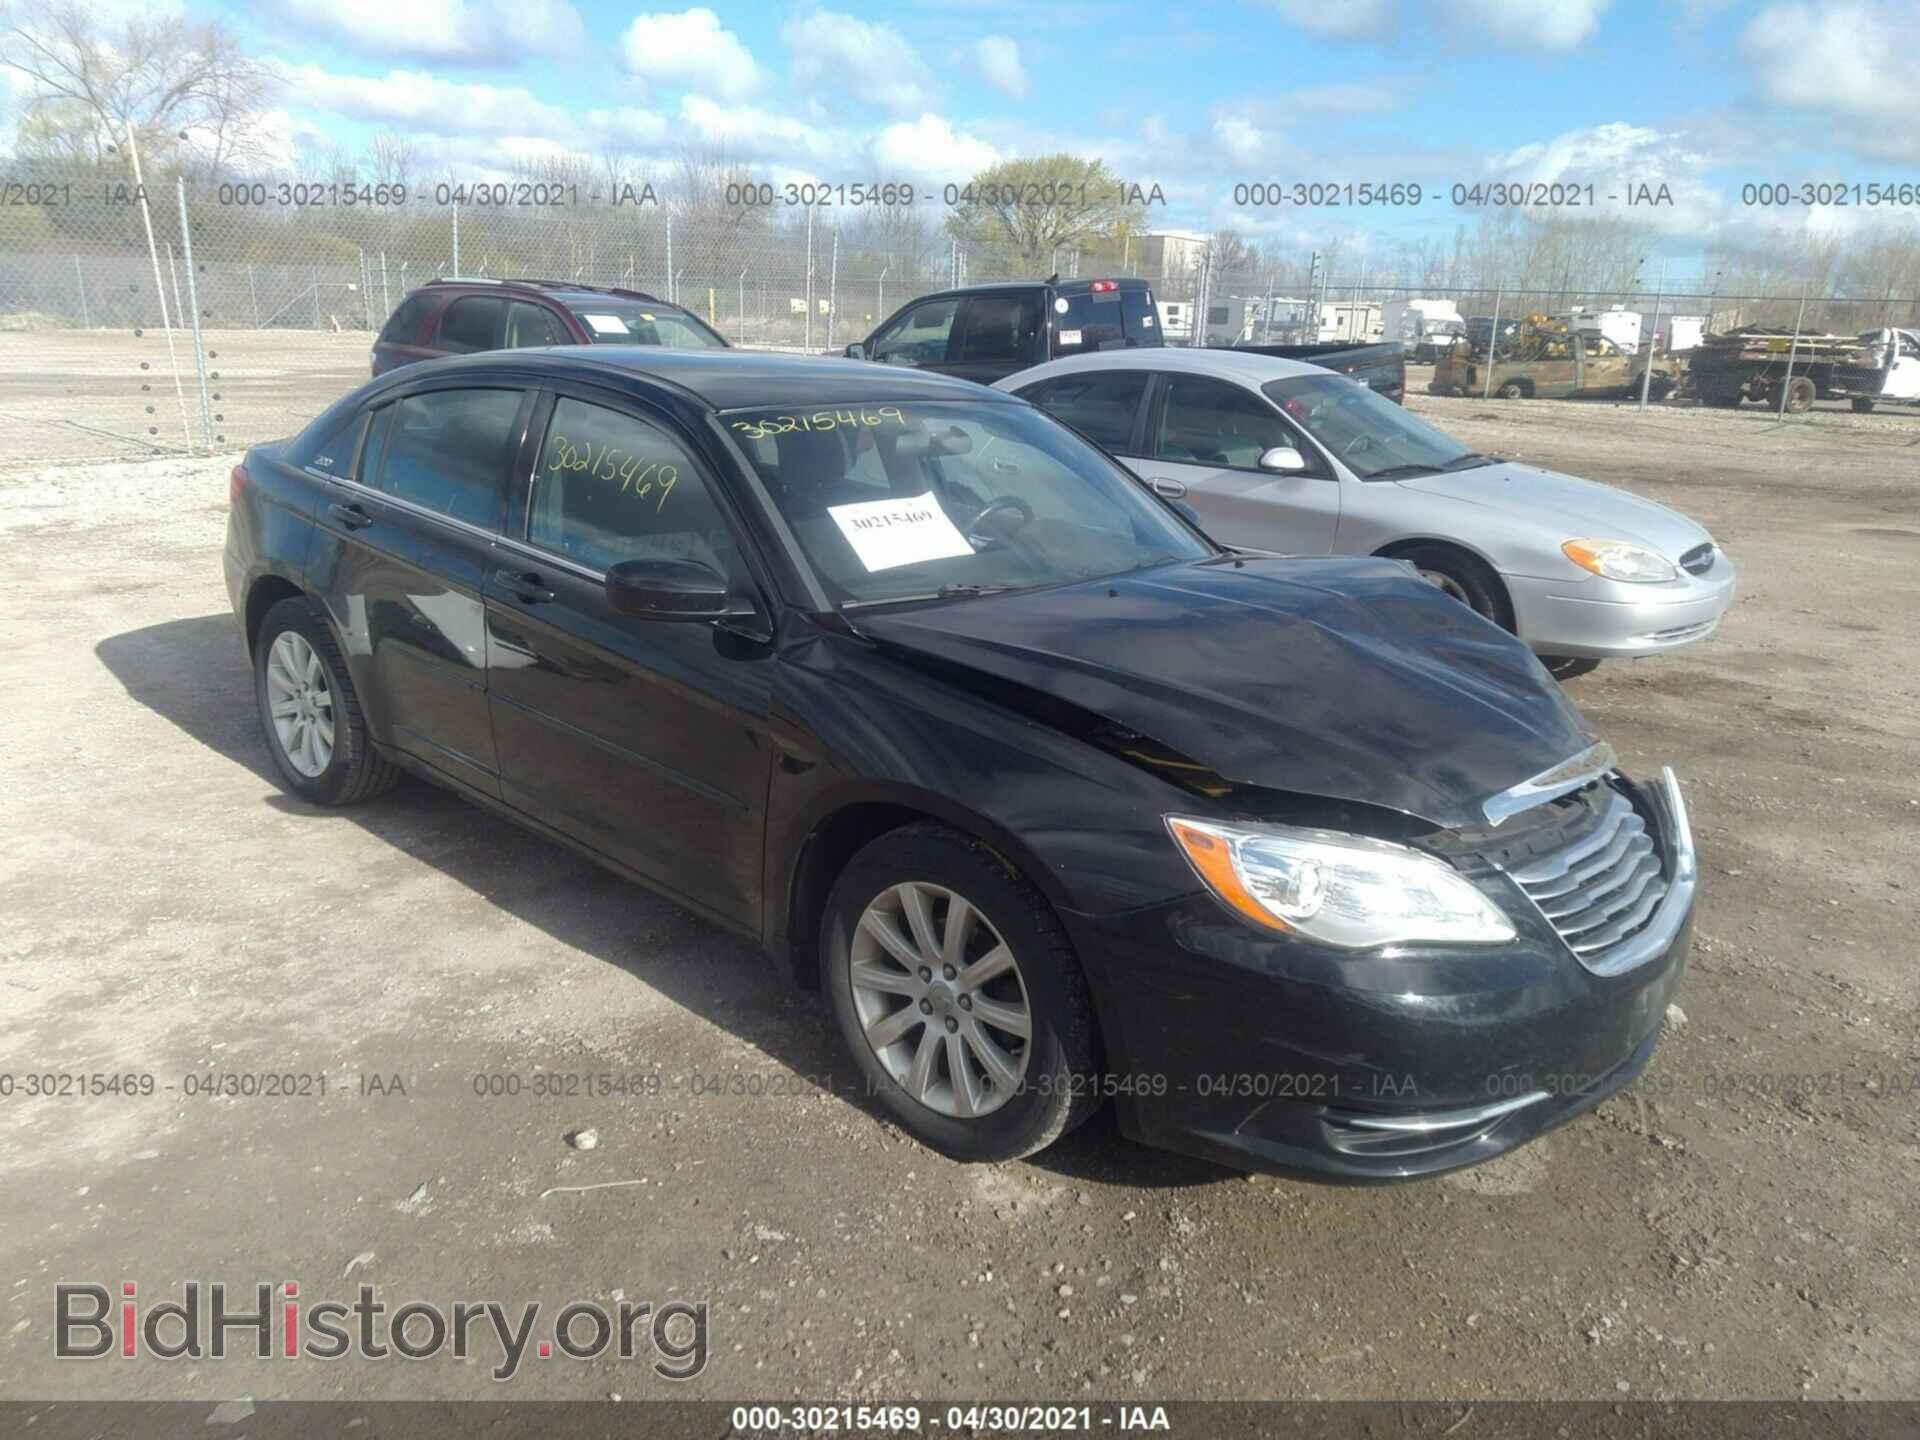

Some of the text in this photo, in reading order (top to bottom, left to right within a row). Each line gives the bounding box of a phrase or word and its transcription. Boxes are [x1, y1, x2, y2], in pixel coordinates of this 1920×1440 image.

[732, 406, 906, 440] 30215469
[548, 436, 680, 513] 30215469
[850, 511, 934, 530] 30215469
